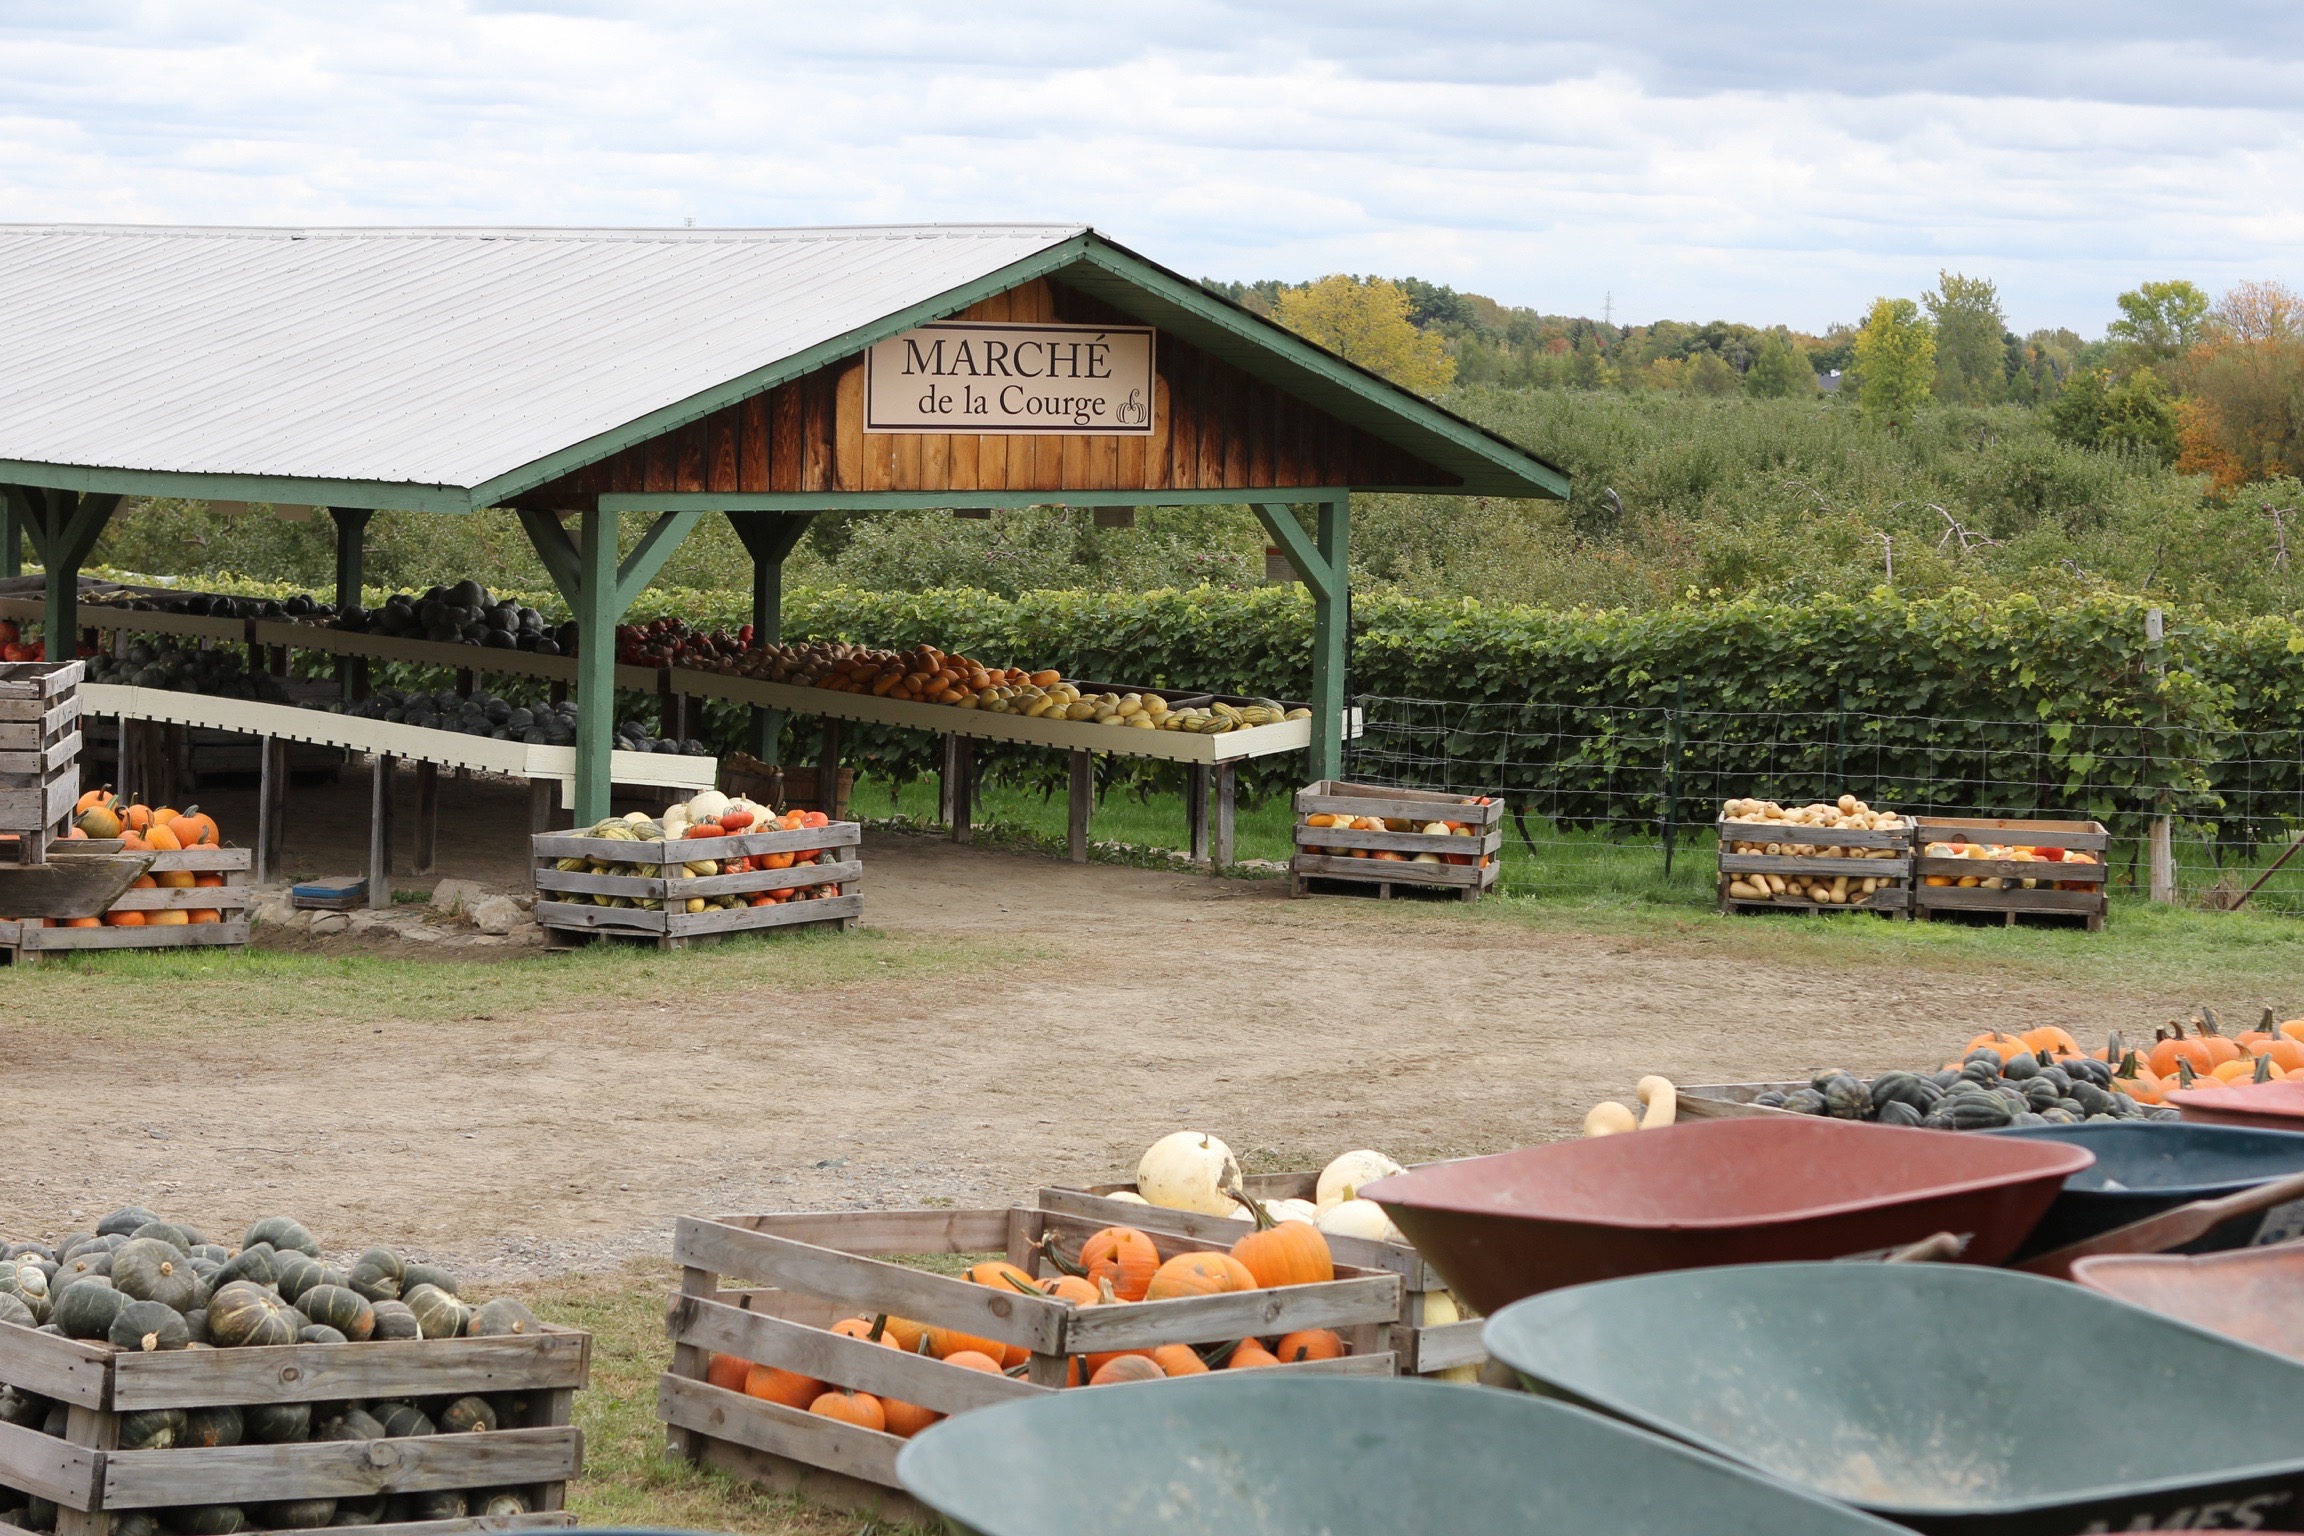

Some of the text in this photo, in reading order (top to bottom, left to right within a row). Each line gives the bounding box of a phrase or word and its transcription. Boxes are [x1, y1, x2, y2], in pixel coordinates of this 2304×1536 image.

[901, 333, 1112, 379] MARCHÉ
[918, 383, 1106, 426] de la Courge
